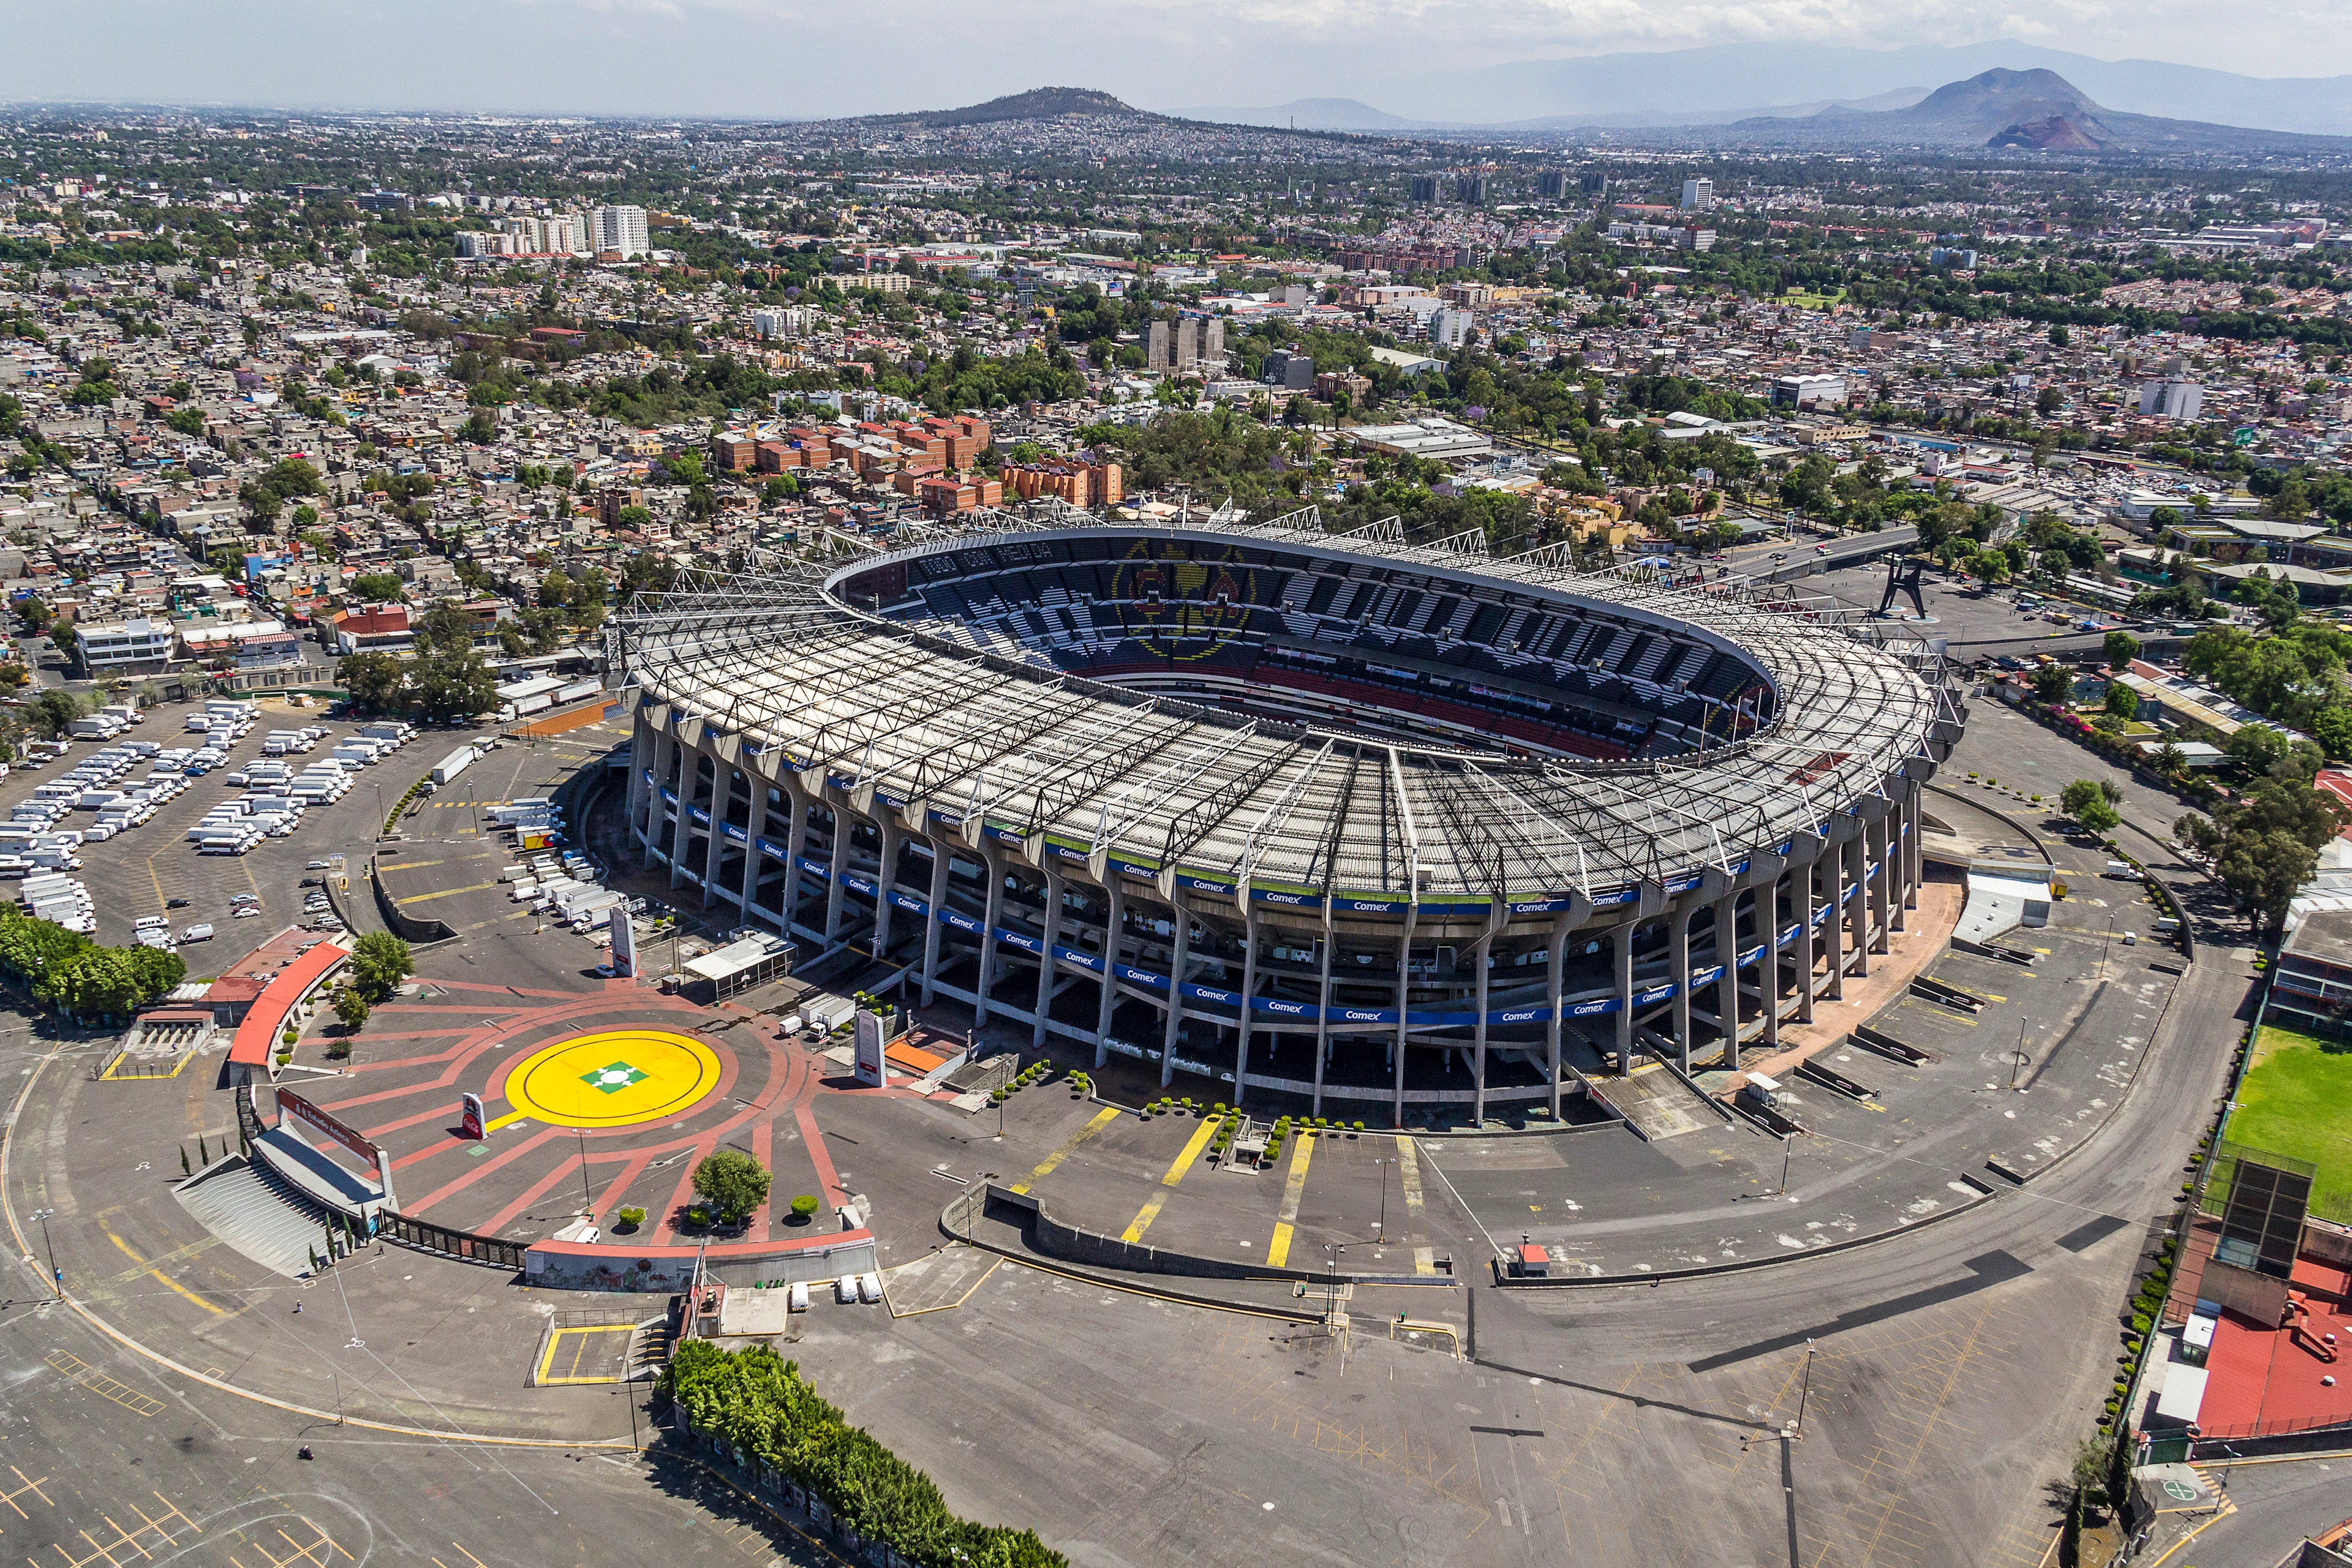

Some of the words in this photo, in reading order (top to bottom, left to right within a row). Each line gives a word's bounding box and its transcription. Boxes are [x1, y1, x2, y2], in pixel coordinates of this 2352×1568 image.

[888, 798, 905, 809] Come
[694, 810, 709, 822] Comex
[941, 815, 960, 826] Come
[729, 827, 747, 840] Comex
[765, 844, 783, 857] Comex
[1060, 848, 1087, 862] Comex
[805, 862, 824, 875] Comex
[1124, 865, 1154, 878] Comex
[850, 880, 871, 892] Comex
[1194, 880, 1226, 892] Comex
[898, 898, 921, 911] Comex
[1267, 893, 1302, 905] Comex
[1593, 894, 1623, 906] Comex
[1354, 902, 1390, 912] Comex
[1517, 903, 1551, 912] Comex
[950, 916, 975, 930] Comex
[1006, 934, 1033, 948] Comex
[1066, 952, 1094, 965] Comex
[1740, 951, 1758, 967] Comex
[1128, 970, 1157, 983] Comex
[1693, 971, 1715, 986] Comex
[1197, 989, 1229, 1001] Comex
[1642, 988, 1668, 1003] Comex
[1268, 1001, 1303, 1014] Comex
[1574, 1003, 1606, 1014] Comex
[1346, 1011, 1382, 1021] Comex
[1502, 1011, 1537, 1022] Comex
